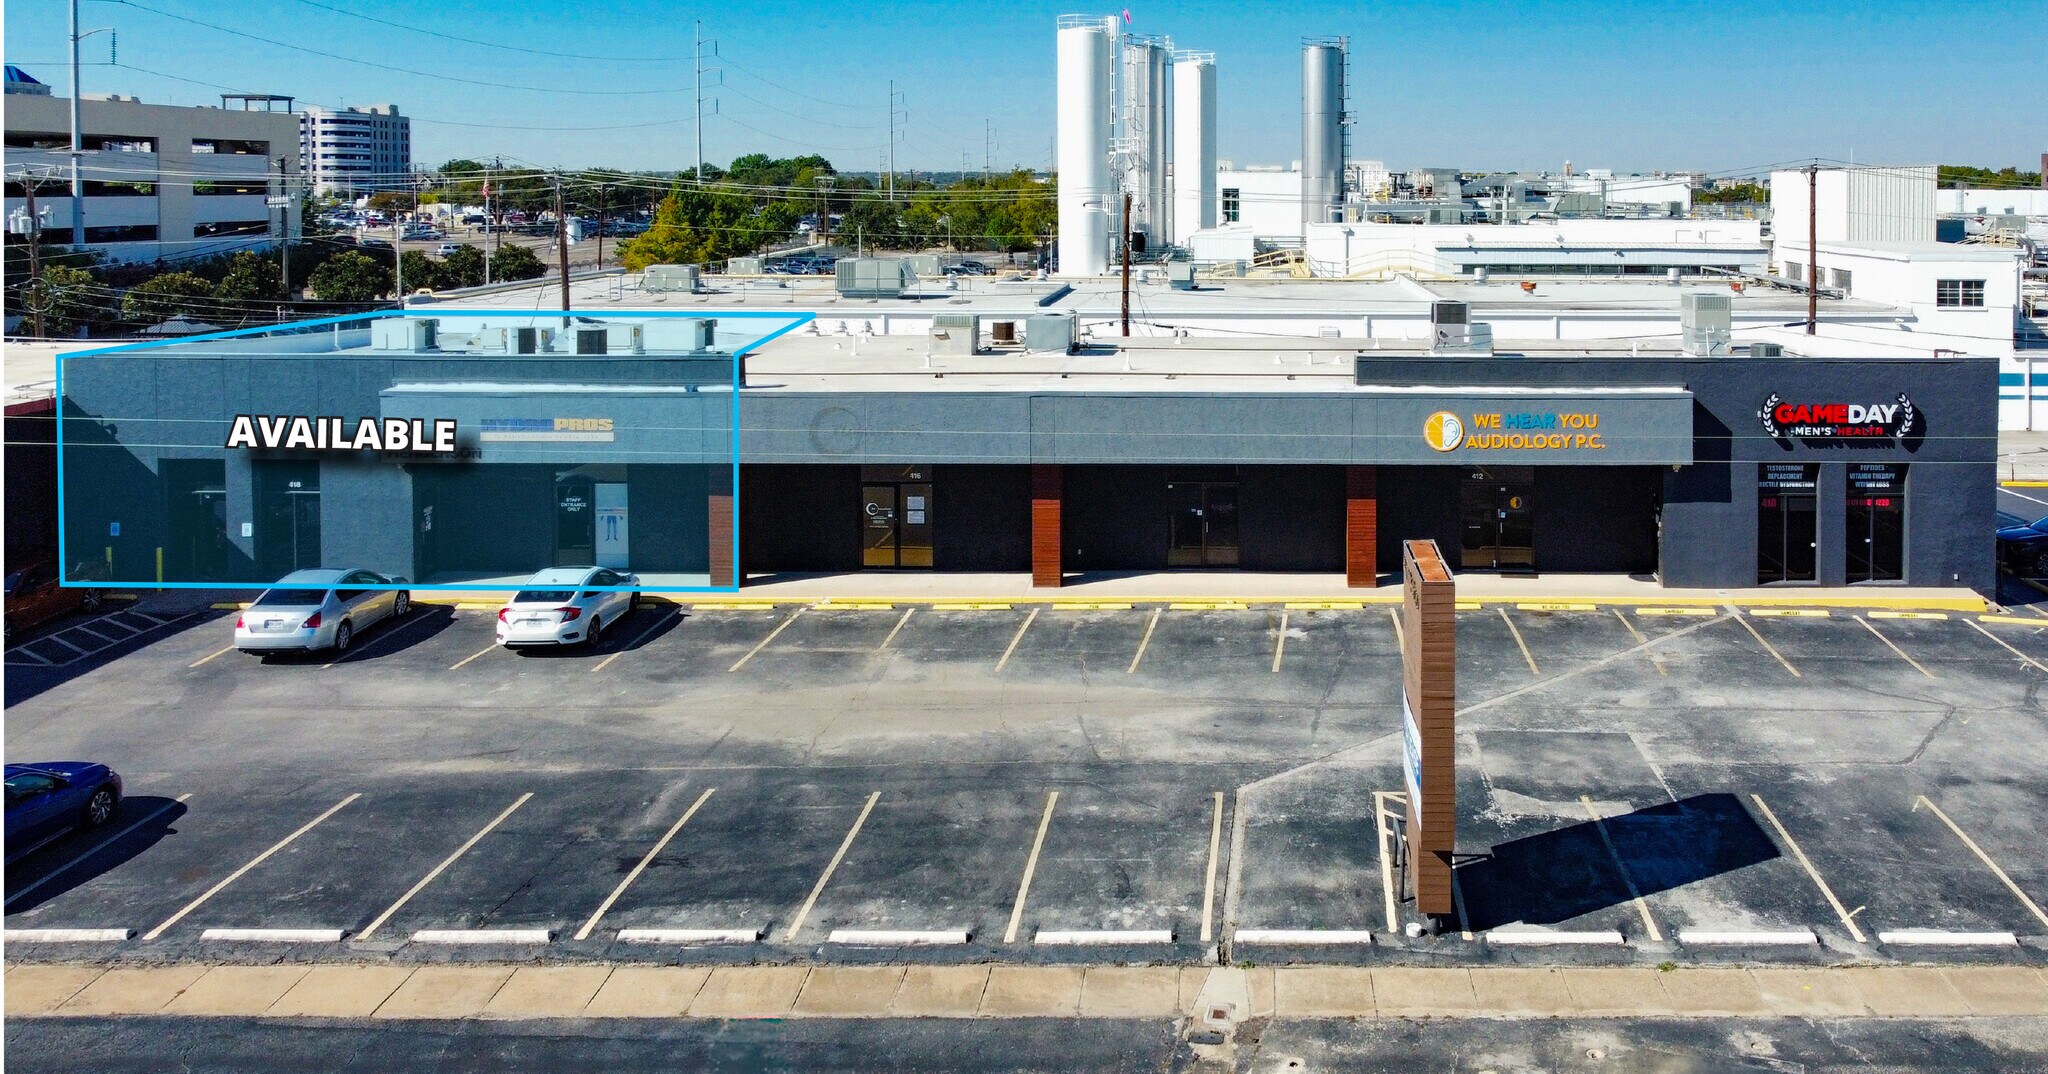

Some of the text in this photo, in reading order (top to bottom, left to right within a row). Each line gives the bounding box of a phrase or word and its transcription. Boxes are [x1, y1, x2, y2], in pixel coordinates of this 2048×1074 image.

[1473, 413, 1599, 430] WE HEAR YOU
[1775, 404, 1899, 424] GAMEDAY
[1837, 427, 1884, 436] HEALTH
[1465, 434, 1606, 449] AUDIOLOGY P.C.
